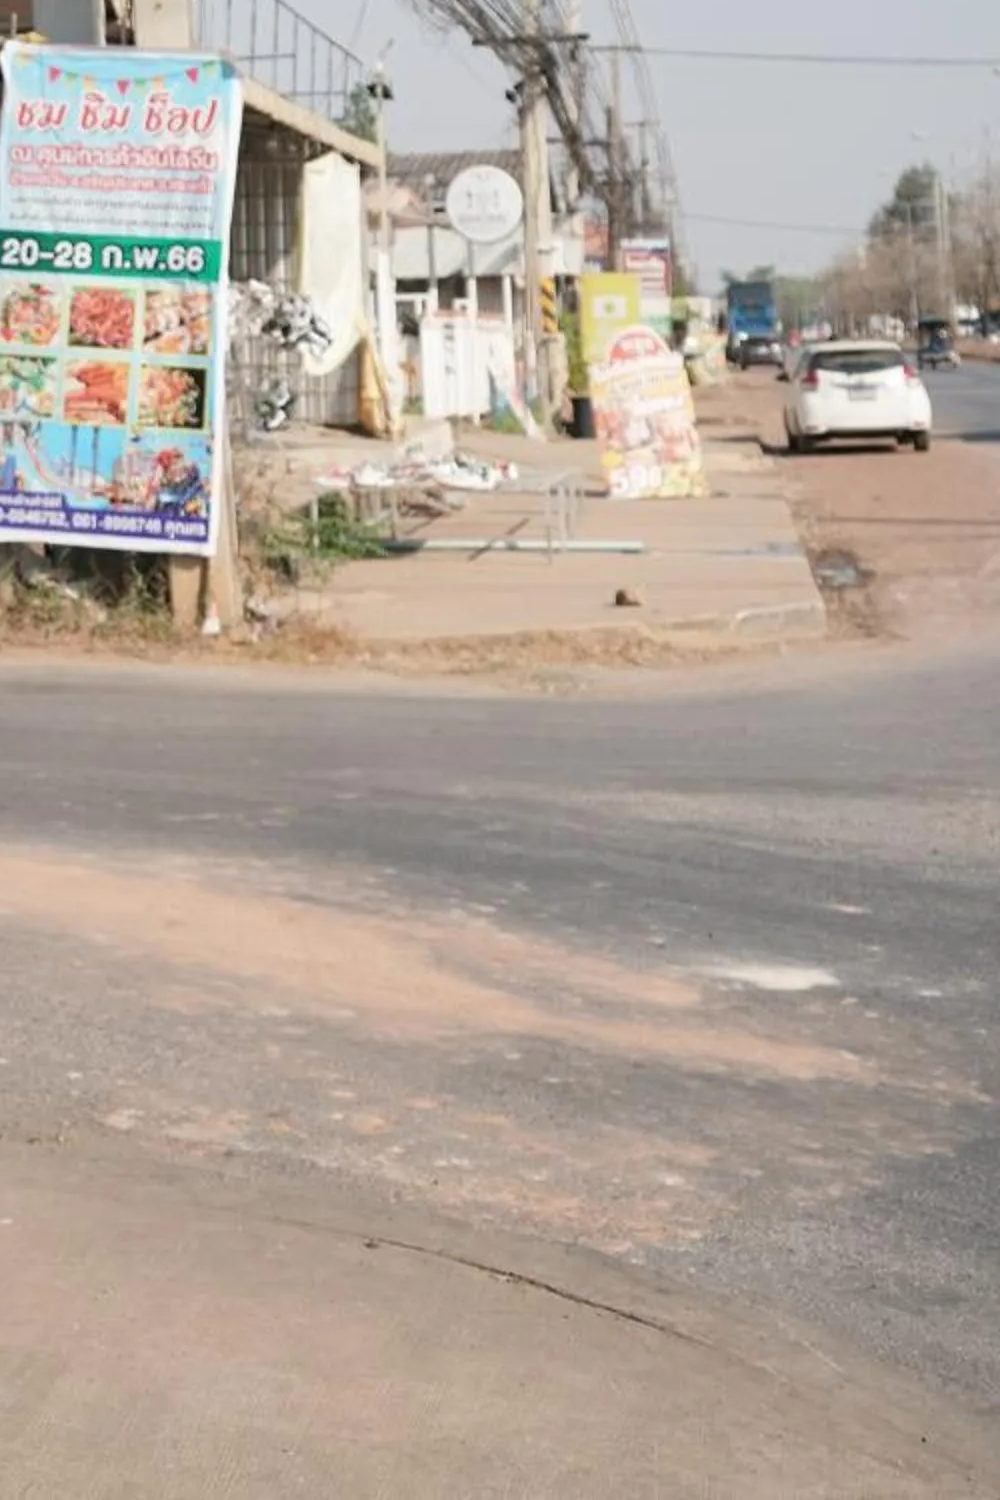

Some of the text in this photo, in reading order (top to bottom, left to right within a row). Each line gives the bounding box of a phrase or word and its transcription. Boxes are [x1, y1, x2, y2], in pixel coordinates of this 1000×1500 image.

[17, 91, 219, 134] ชม ชิม ช็อป
[1, 237, 205, 273] 20-28 ก.พ.66
